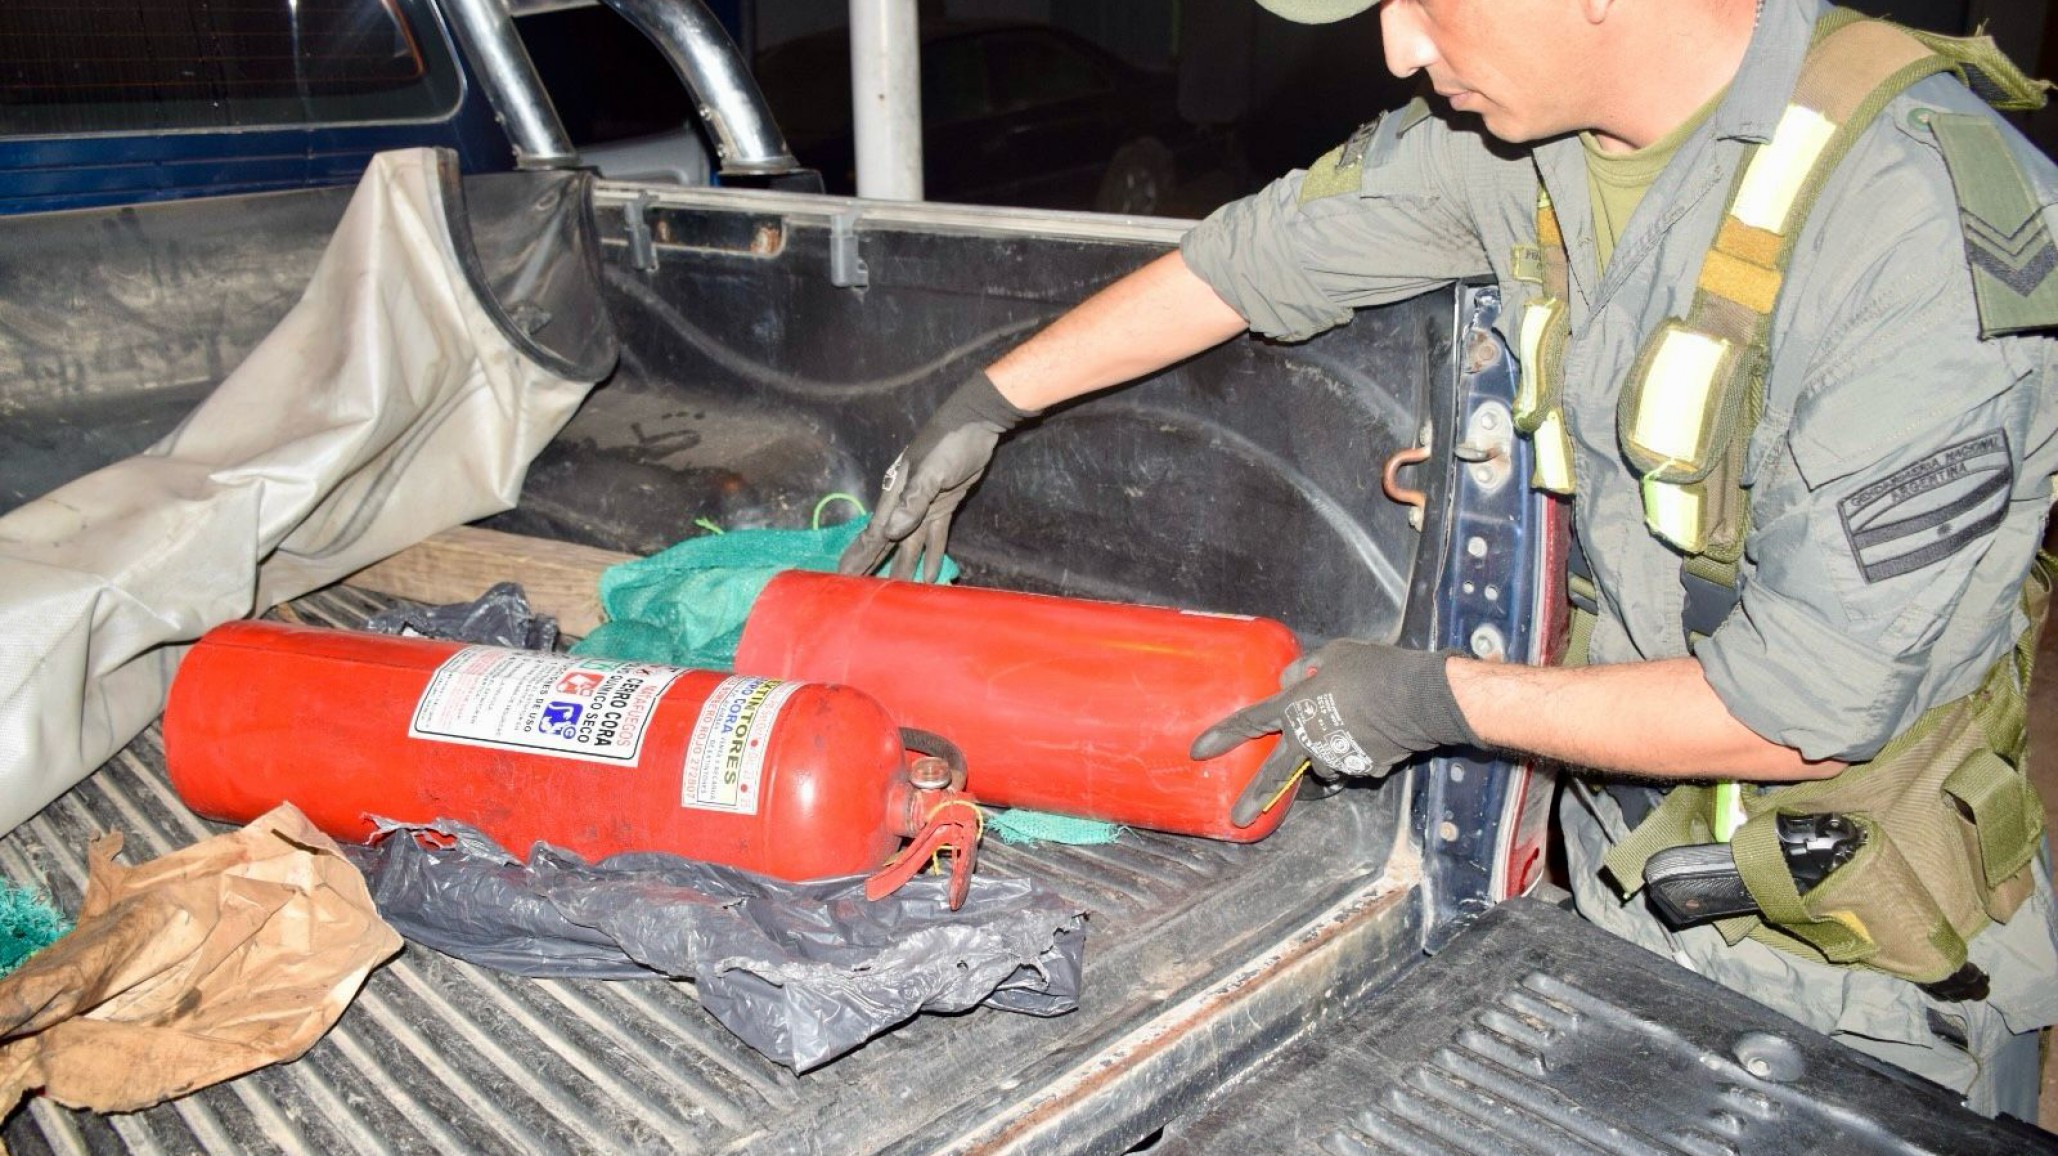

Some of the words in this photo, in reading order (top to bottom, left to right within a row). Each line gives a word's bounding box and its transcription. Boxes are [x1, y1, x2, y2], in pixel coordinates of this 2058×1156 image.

[1850, 458, 1941, 507] GENDARMERIA
[1890, 461, 1967, 503] ARGENTINA
[533, 698, 544, 709] DE
[590, 675, 623, 710] QUIMICO
[610, 677, 644, 709] CERRO
[524, 712, 537, 732] USO
[577, 713, 598, 743] SECO
[594, 712, 622, 746] CORA
[617, 684, 657, 747] MATAFUEGOS
[721, 698, 747, 733] CORA
[724, 680, 782, 785] EXTINTORES
[693, 726, 710, 754] ROJO
